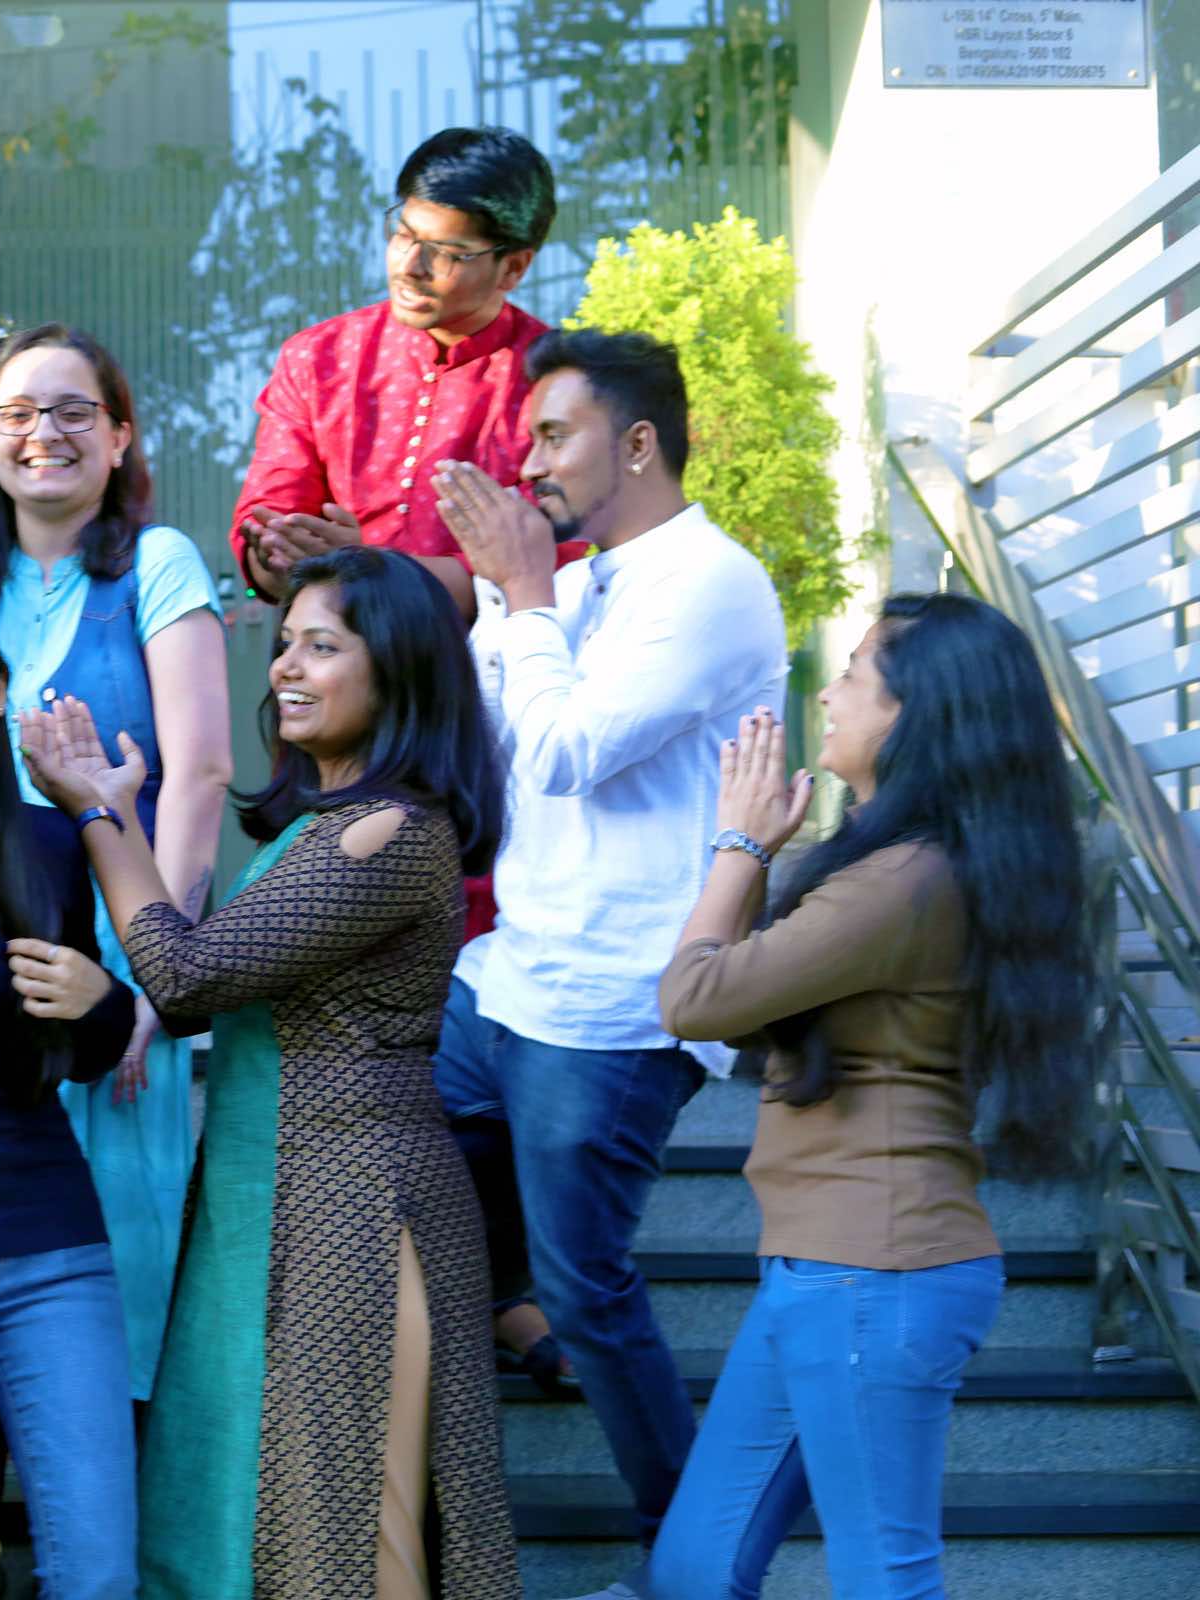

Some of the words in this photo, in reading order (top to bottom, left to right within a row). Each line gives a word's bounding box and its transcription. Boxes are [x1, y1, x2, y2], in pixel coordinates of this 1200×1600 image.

[984, 27, 1023, 44] Layout
[1026, 27, 1063, 41] Sector
[959, 46, 1018, 62] Bengaluru
